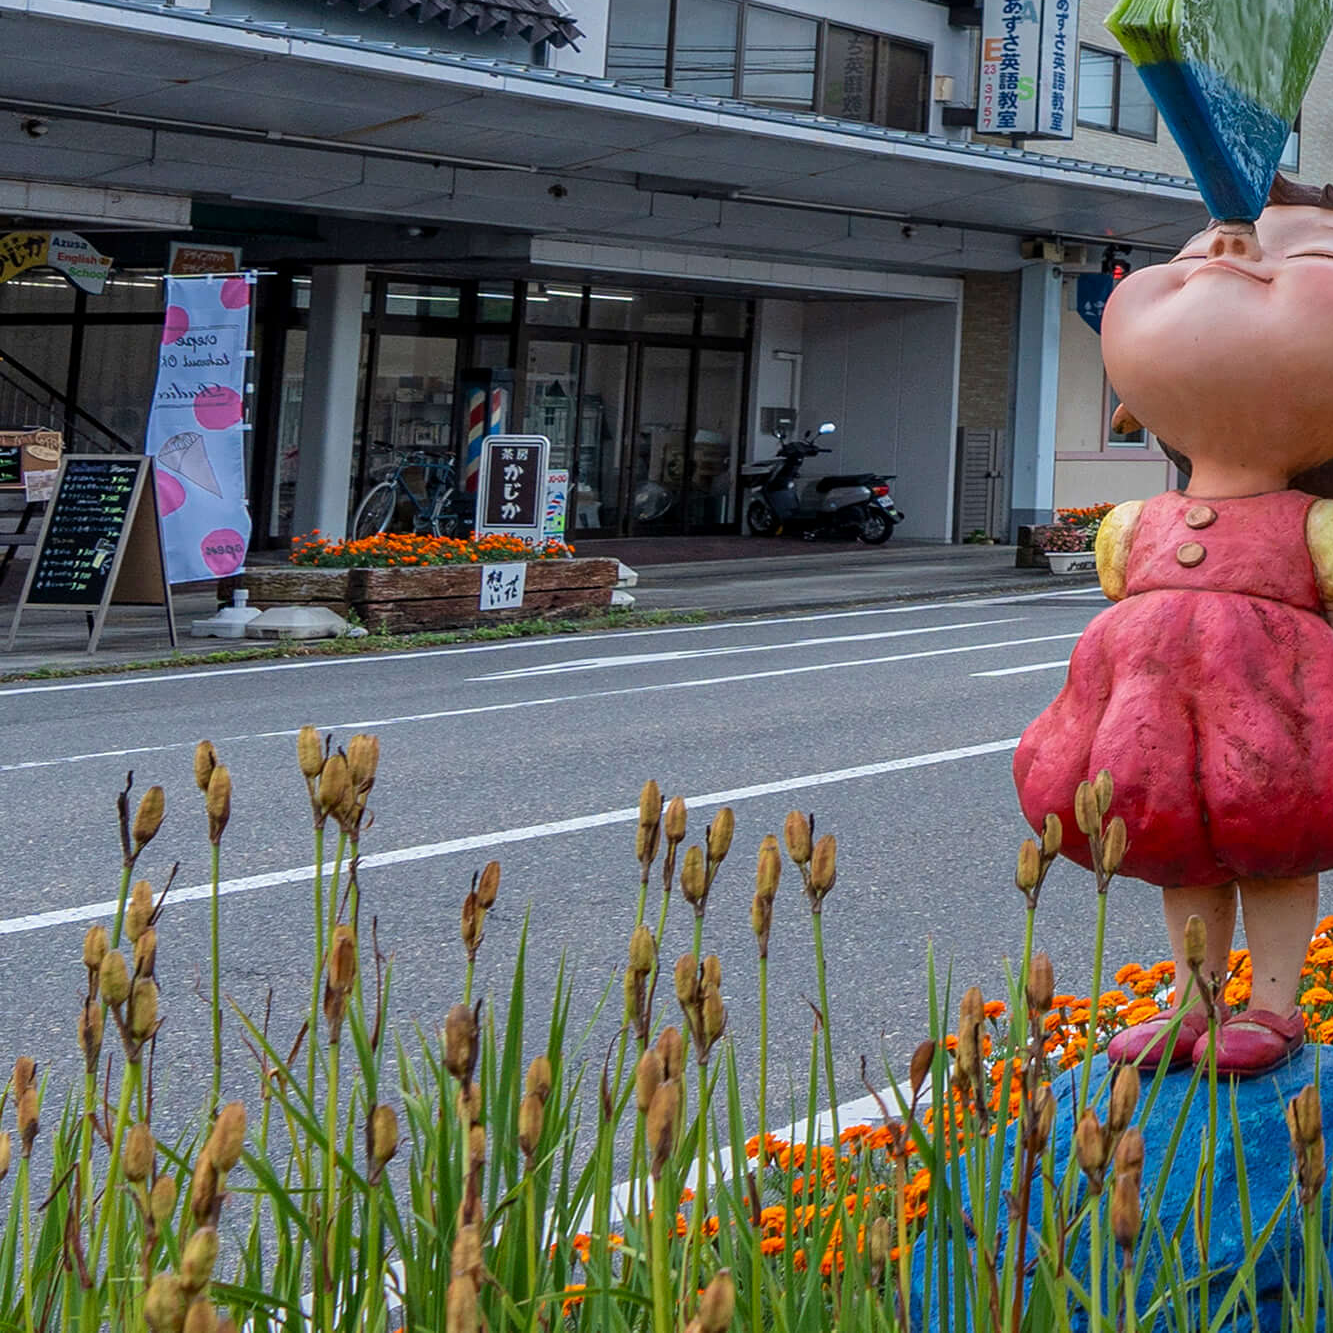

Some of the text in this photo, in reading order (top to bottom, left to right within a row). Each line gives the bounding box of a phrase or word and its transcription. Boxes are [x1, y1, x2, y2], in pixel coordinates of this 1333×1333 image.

[52, 237, 88, 250] Azusa
[57, 251, 97, 264] English
[69, 267, 107, 280] School
[501, 464, 524, 519] かじか
